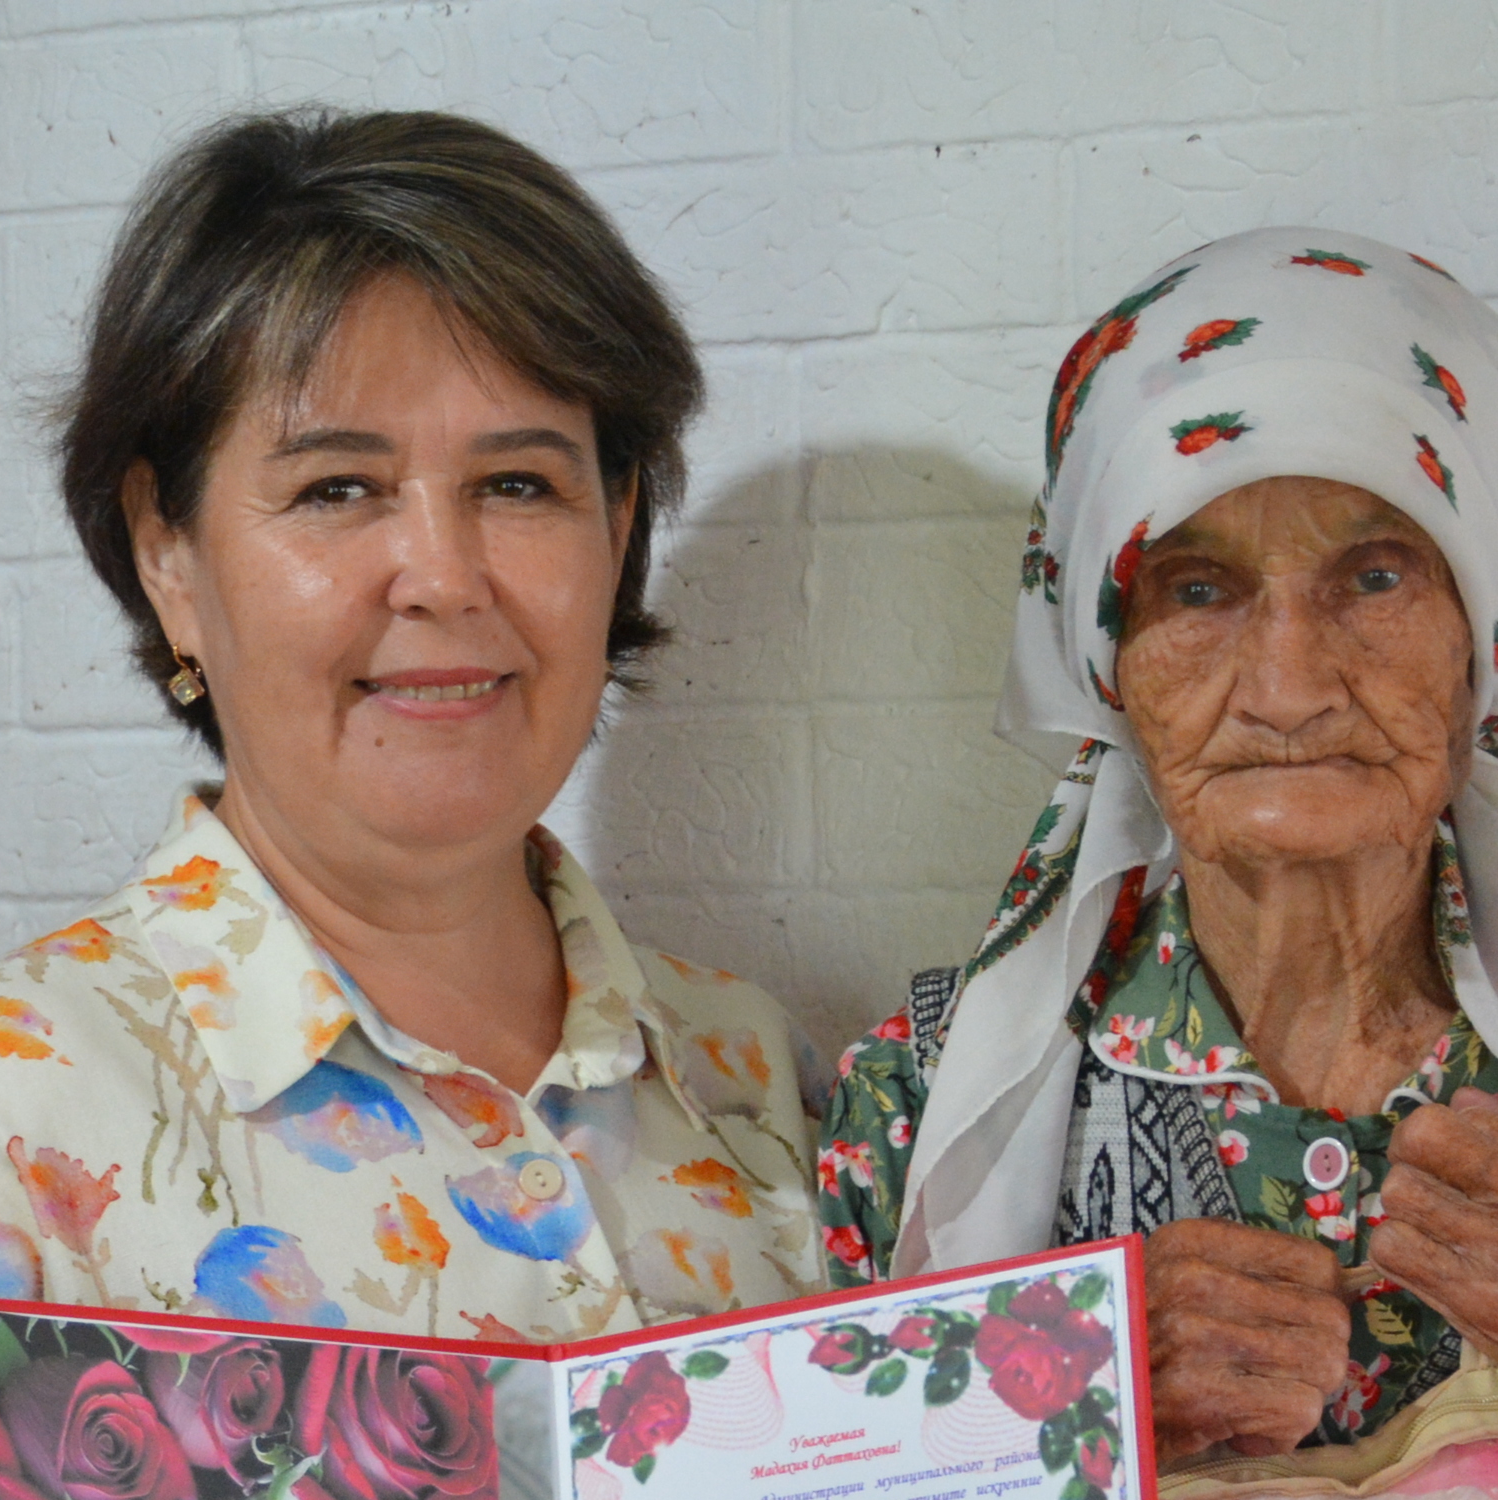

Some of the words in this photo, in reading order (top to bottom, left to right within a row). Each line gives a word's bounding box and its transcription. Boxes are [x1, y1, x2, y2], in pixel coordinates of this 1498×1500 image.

[789, 1428, 865, 1452] Уважаемая
[874, 1460, 983, 1491] муниципального
[993, 1449, 1042, 1472] района
[976, 1475, 1042, 1497] искренние
